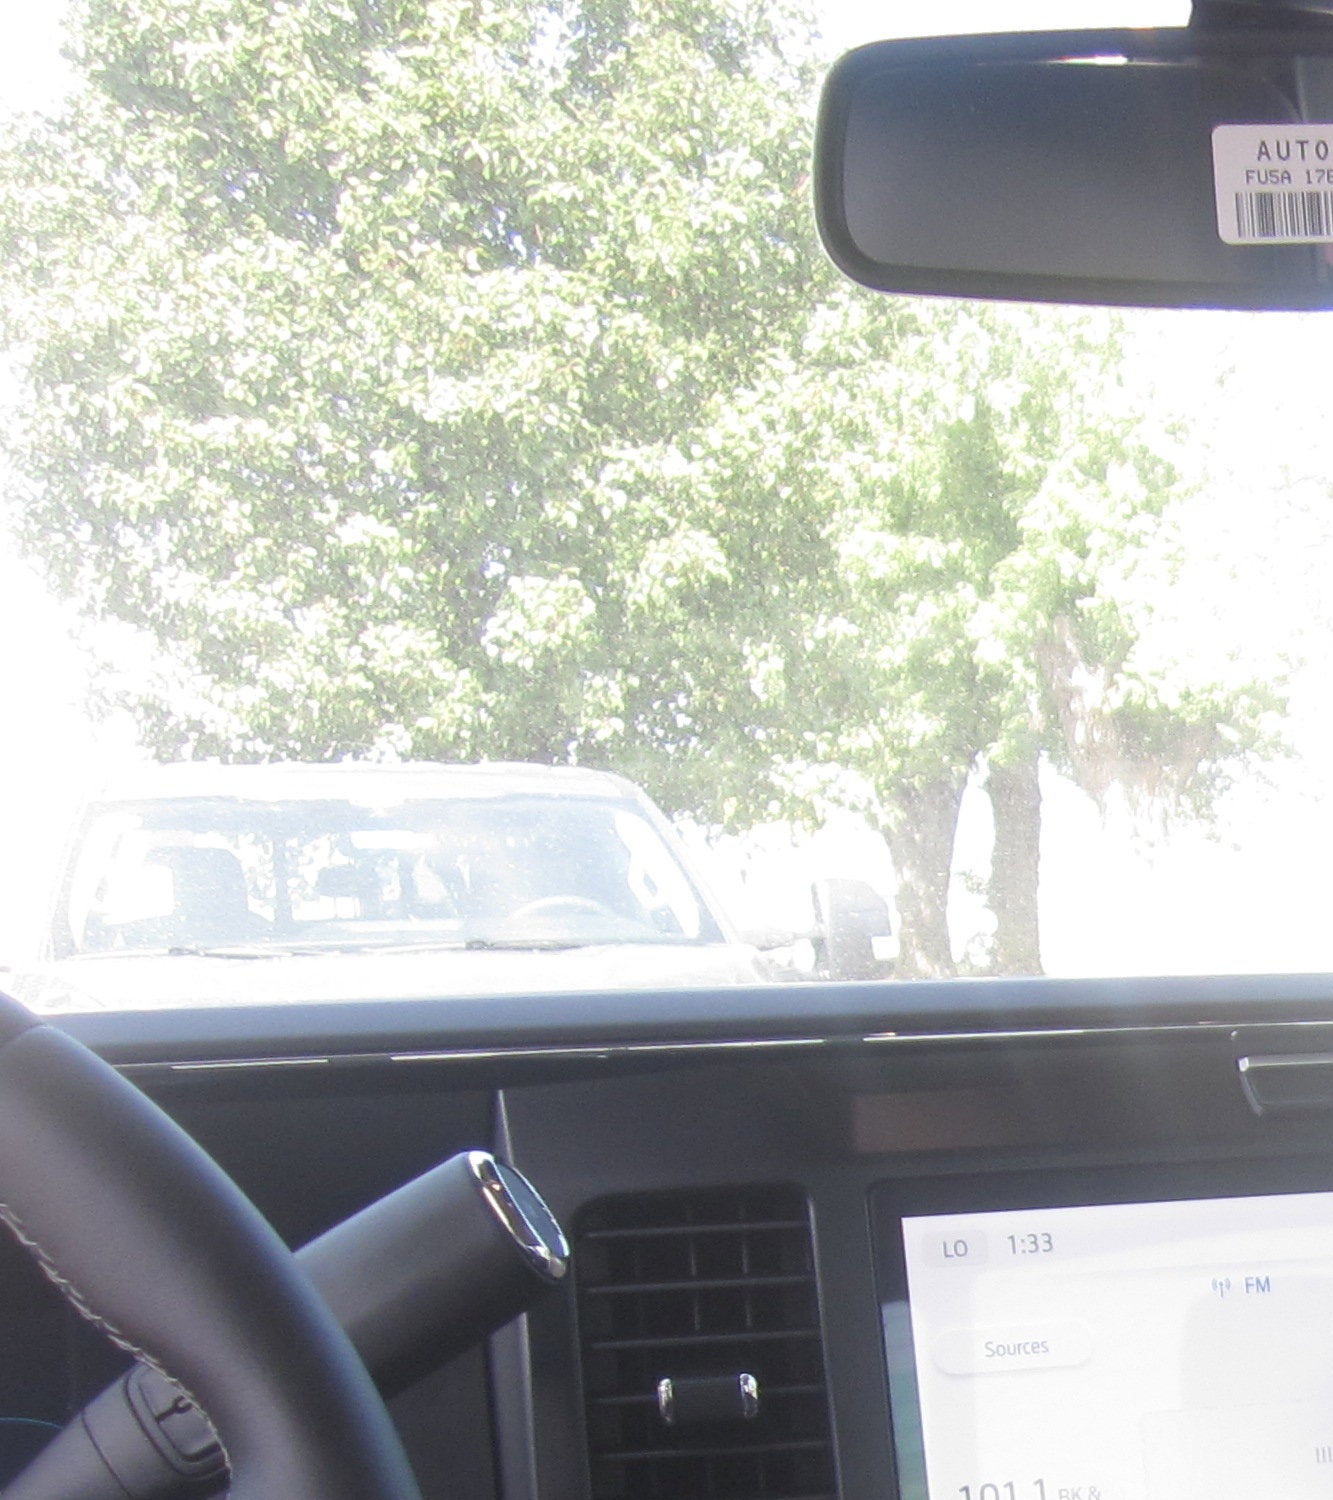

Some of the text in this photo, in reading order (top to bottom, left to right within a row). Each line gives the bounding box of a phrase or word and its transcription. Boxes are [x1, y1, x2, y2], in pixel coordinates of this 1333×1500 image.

[943, 1240, 968, 1258] LO
[1007, 1232, 1053, 1255] 1:33
[1245, 1276, 1271, 1294] FM
[984, 1337, 1049, 1359] Sources
